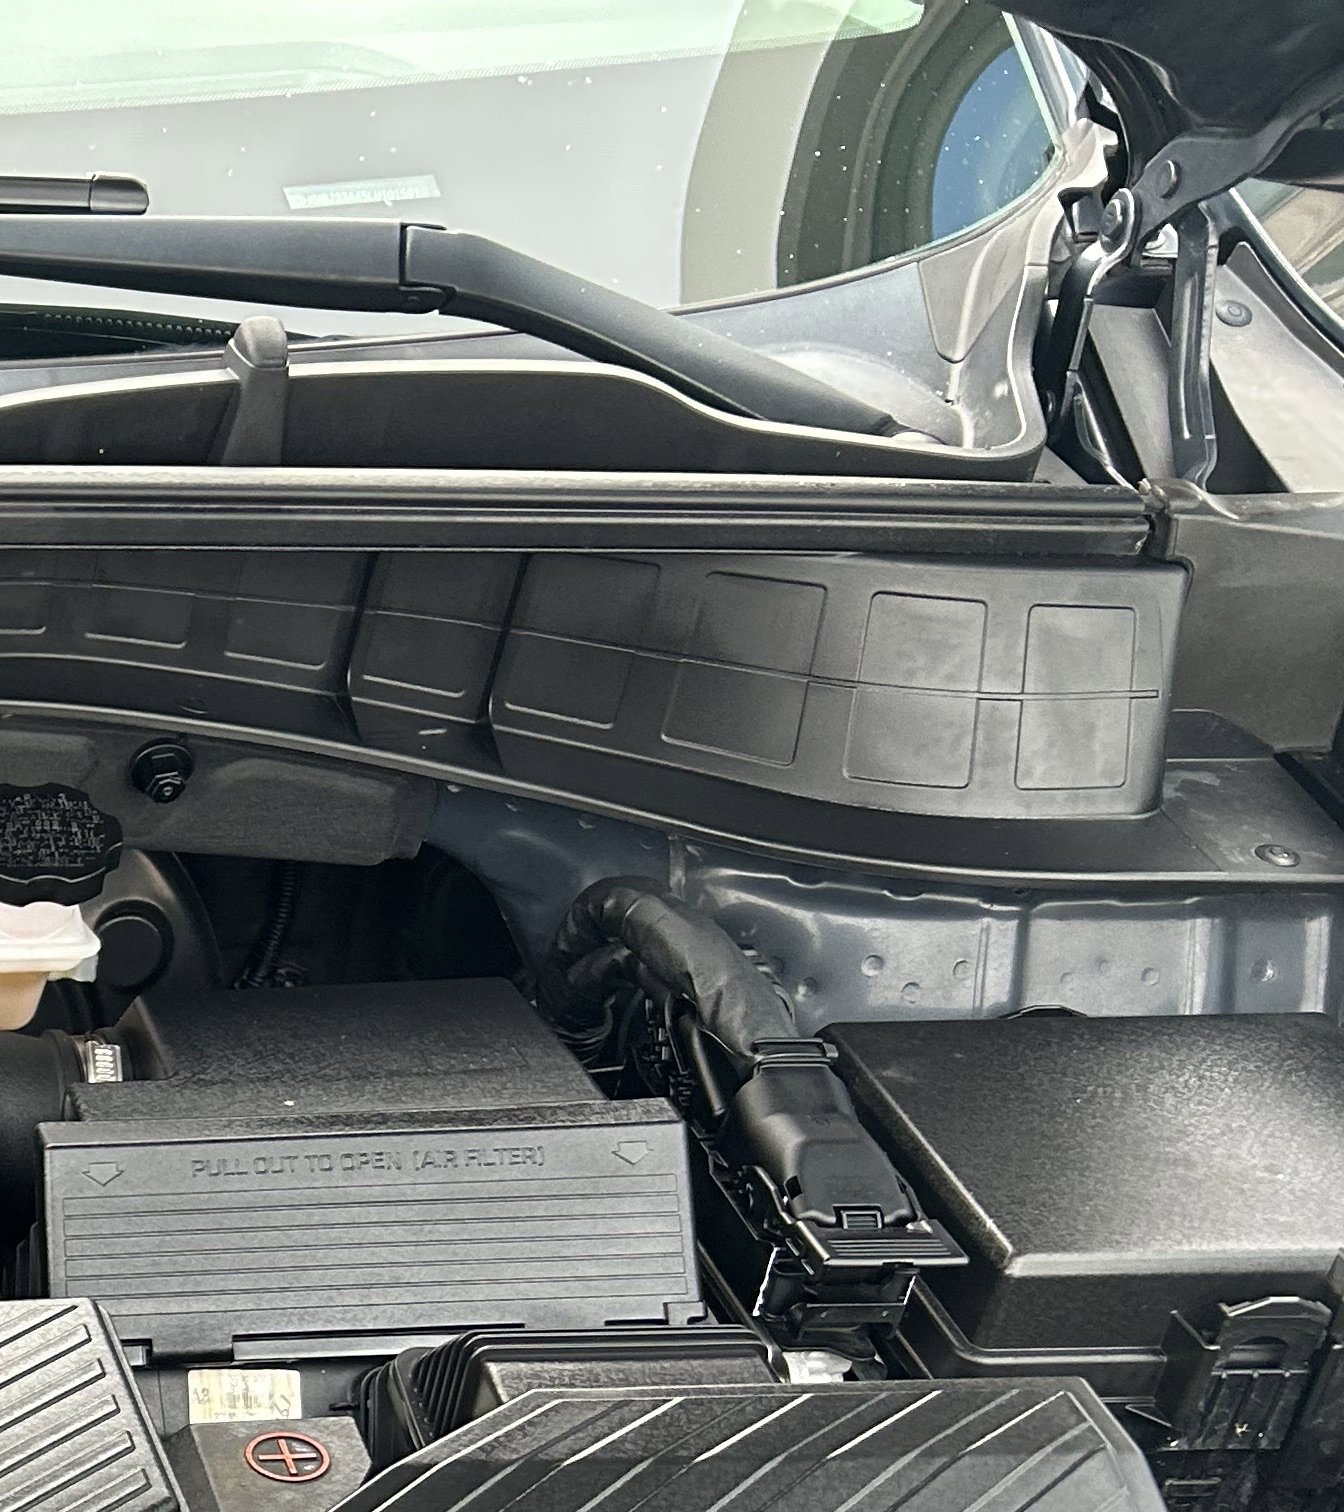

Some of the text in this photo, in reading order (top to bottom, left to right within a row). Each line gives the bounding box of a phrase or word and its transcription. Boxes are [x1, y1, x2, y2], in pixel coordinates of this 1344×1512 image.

[191, 1159, 248, 1178] PULL
[253, 1156, 299, 1174] OUT
[304, 1154, 334, 1173] TO
[339, 1151, 402, 1172] OPEN
